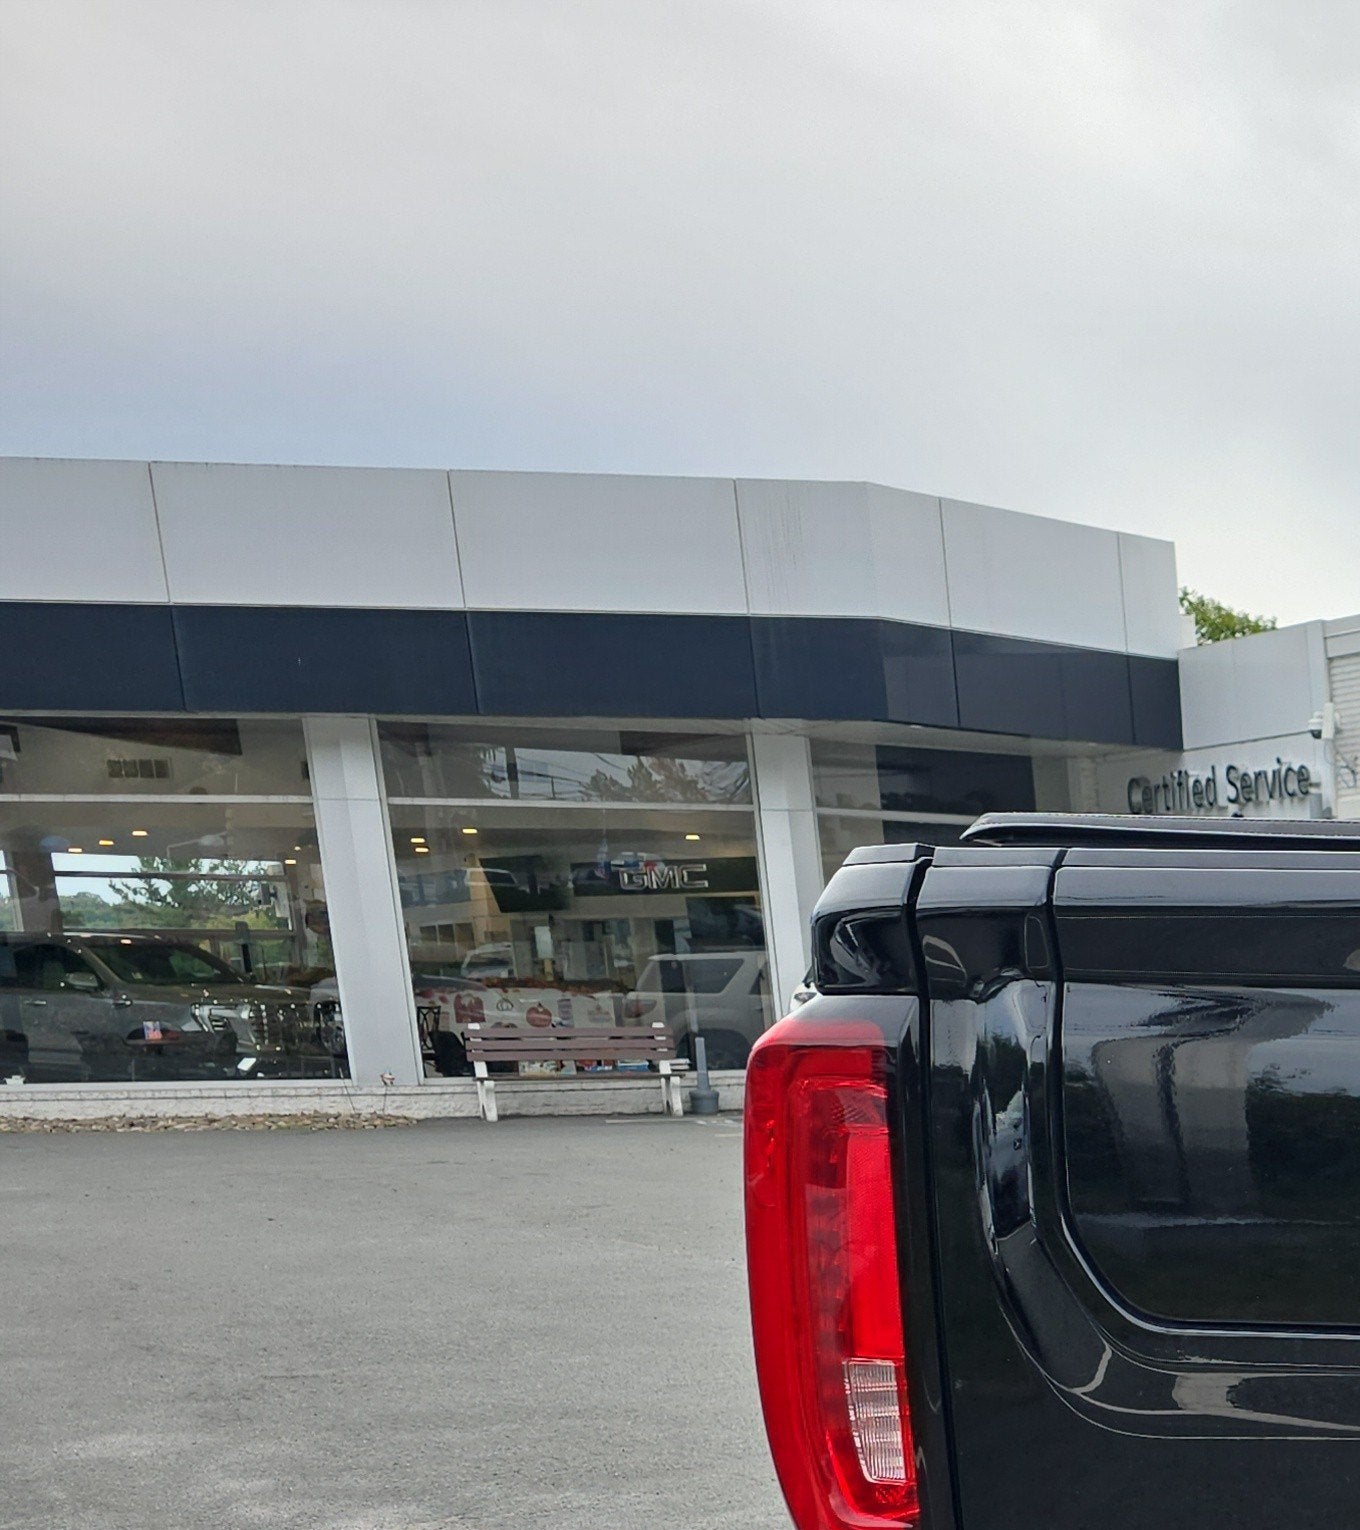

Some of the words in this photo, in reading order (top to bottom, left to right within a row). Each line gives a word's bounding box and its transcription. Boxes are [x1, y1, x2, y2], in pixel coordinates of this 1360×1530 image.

[1127, 765, 1217, 814] Certified
[1225, 757, 1312, 804] Service
[619, 864, 709, 890] GMC
